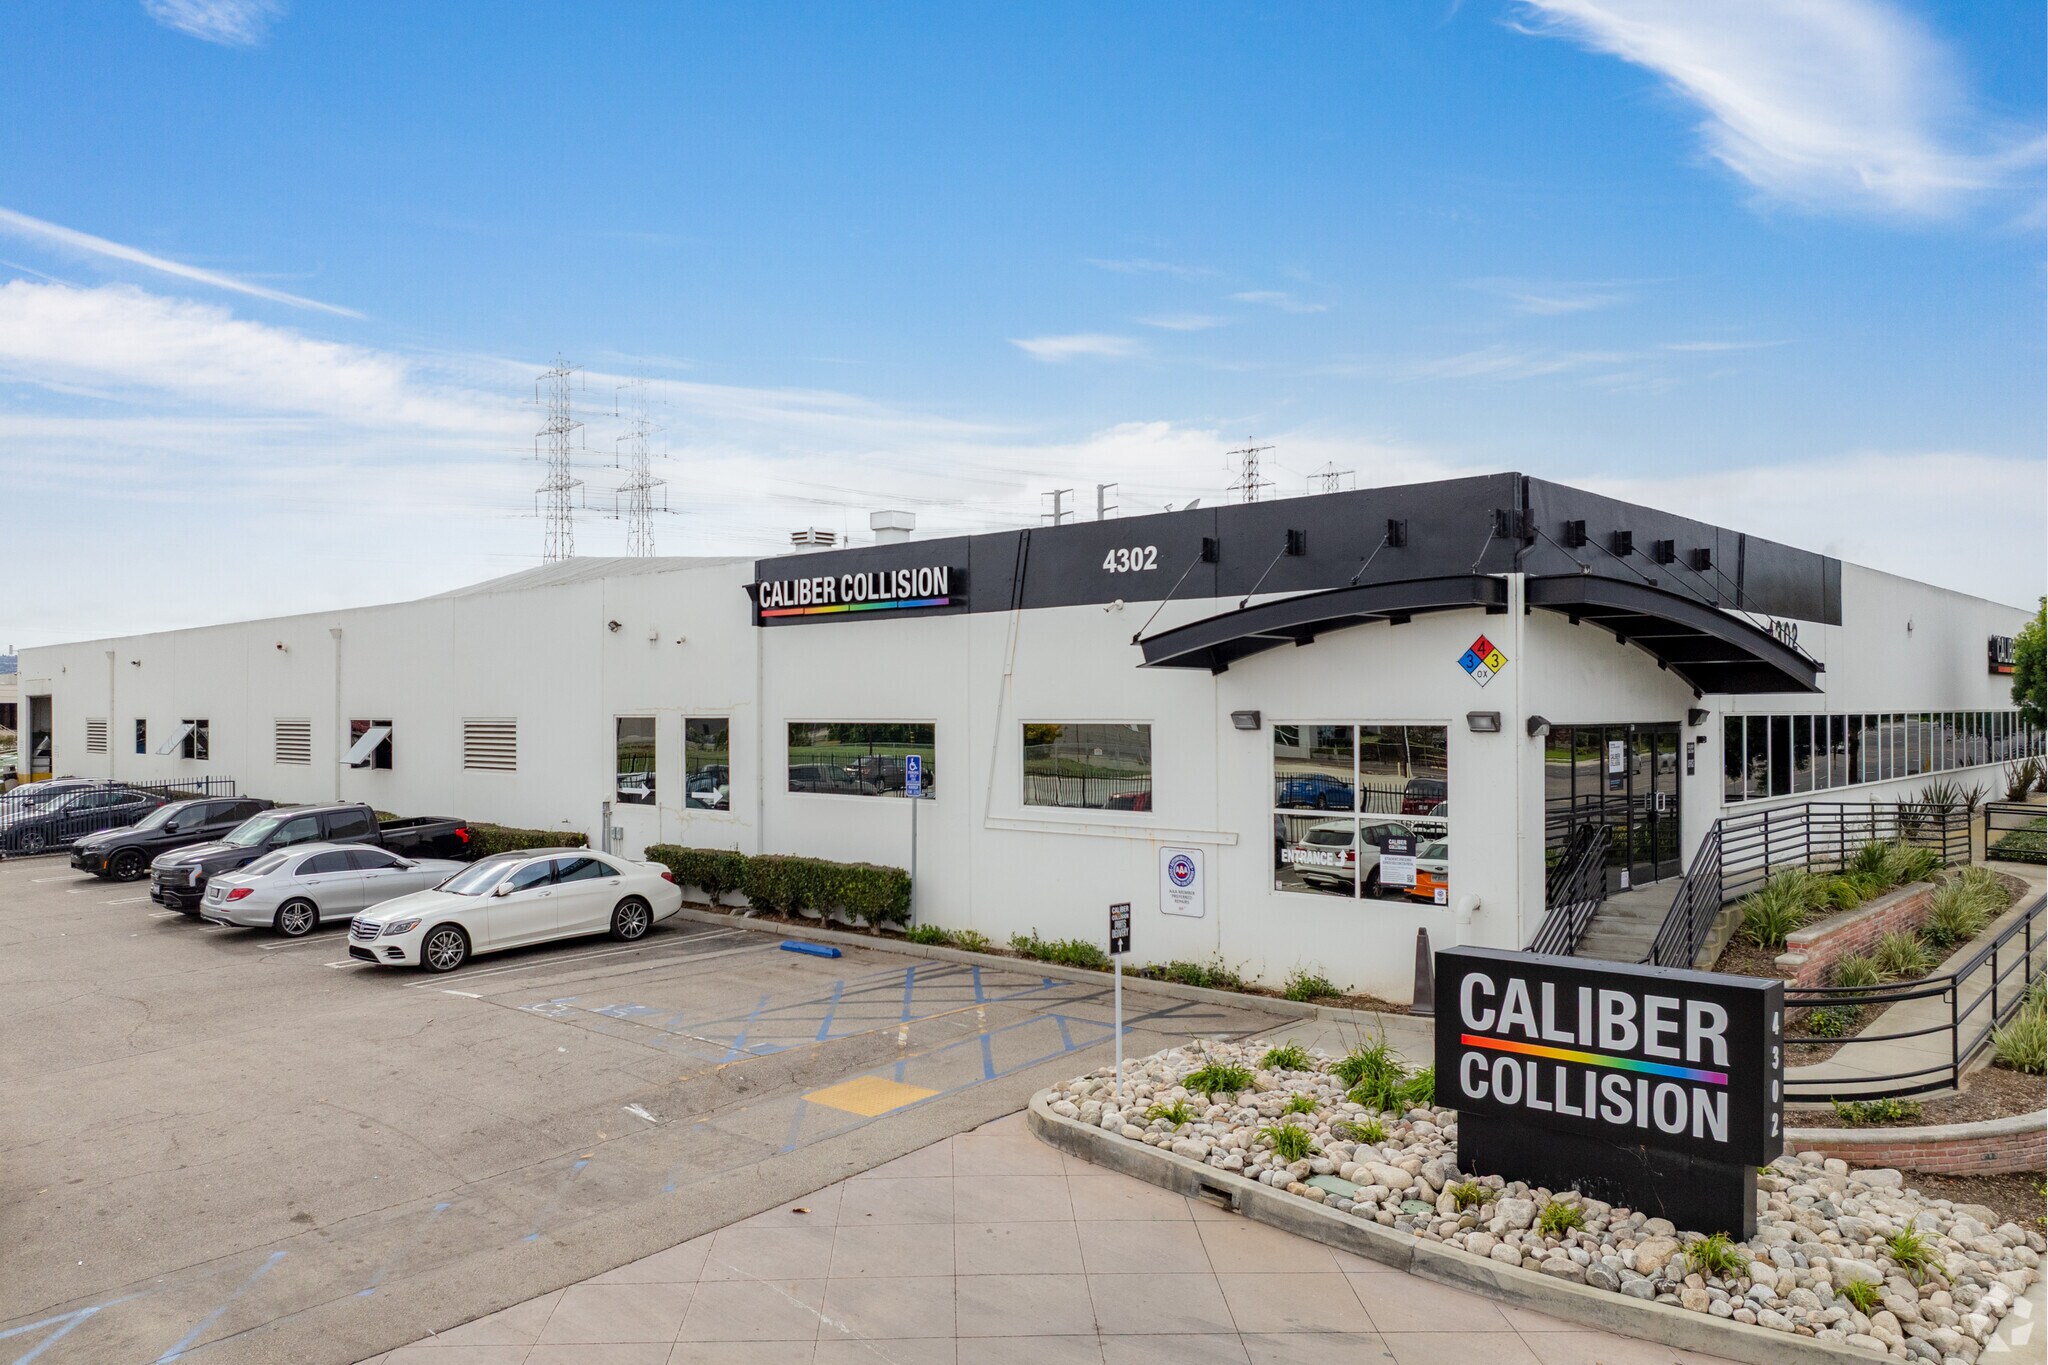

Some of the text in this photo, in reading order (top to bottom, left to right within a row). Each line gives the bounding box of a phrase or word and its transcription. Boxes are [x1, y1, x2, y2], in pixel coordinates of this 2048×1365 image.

[1103, 545, 1158, 573] 4302
[760, 566, 948, 608] CALIBER COLLISION
[1477, 641, 1486, 655] 4
[1466, 653, 1499, 669] 3 3
[1477, 670, 1488, 678] OX
[1281, 848, 1334, 866] ENTRANCE
[1175, 865, 1188, 875] AAA
[1111, 927, 1129, 939] DELIVERY
[1460, 972, 1730, 1067] CALIBER
[1771, 1011, 1780, 1137] 4302
[1460, 1051, 1728, 1143] COLLISION
